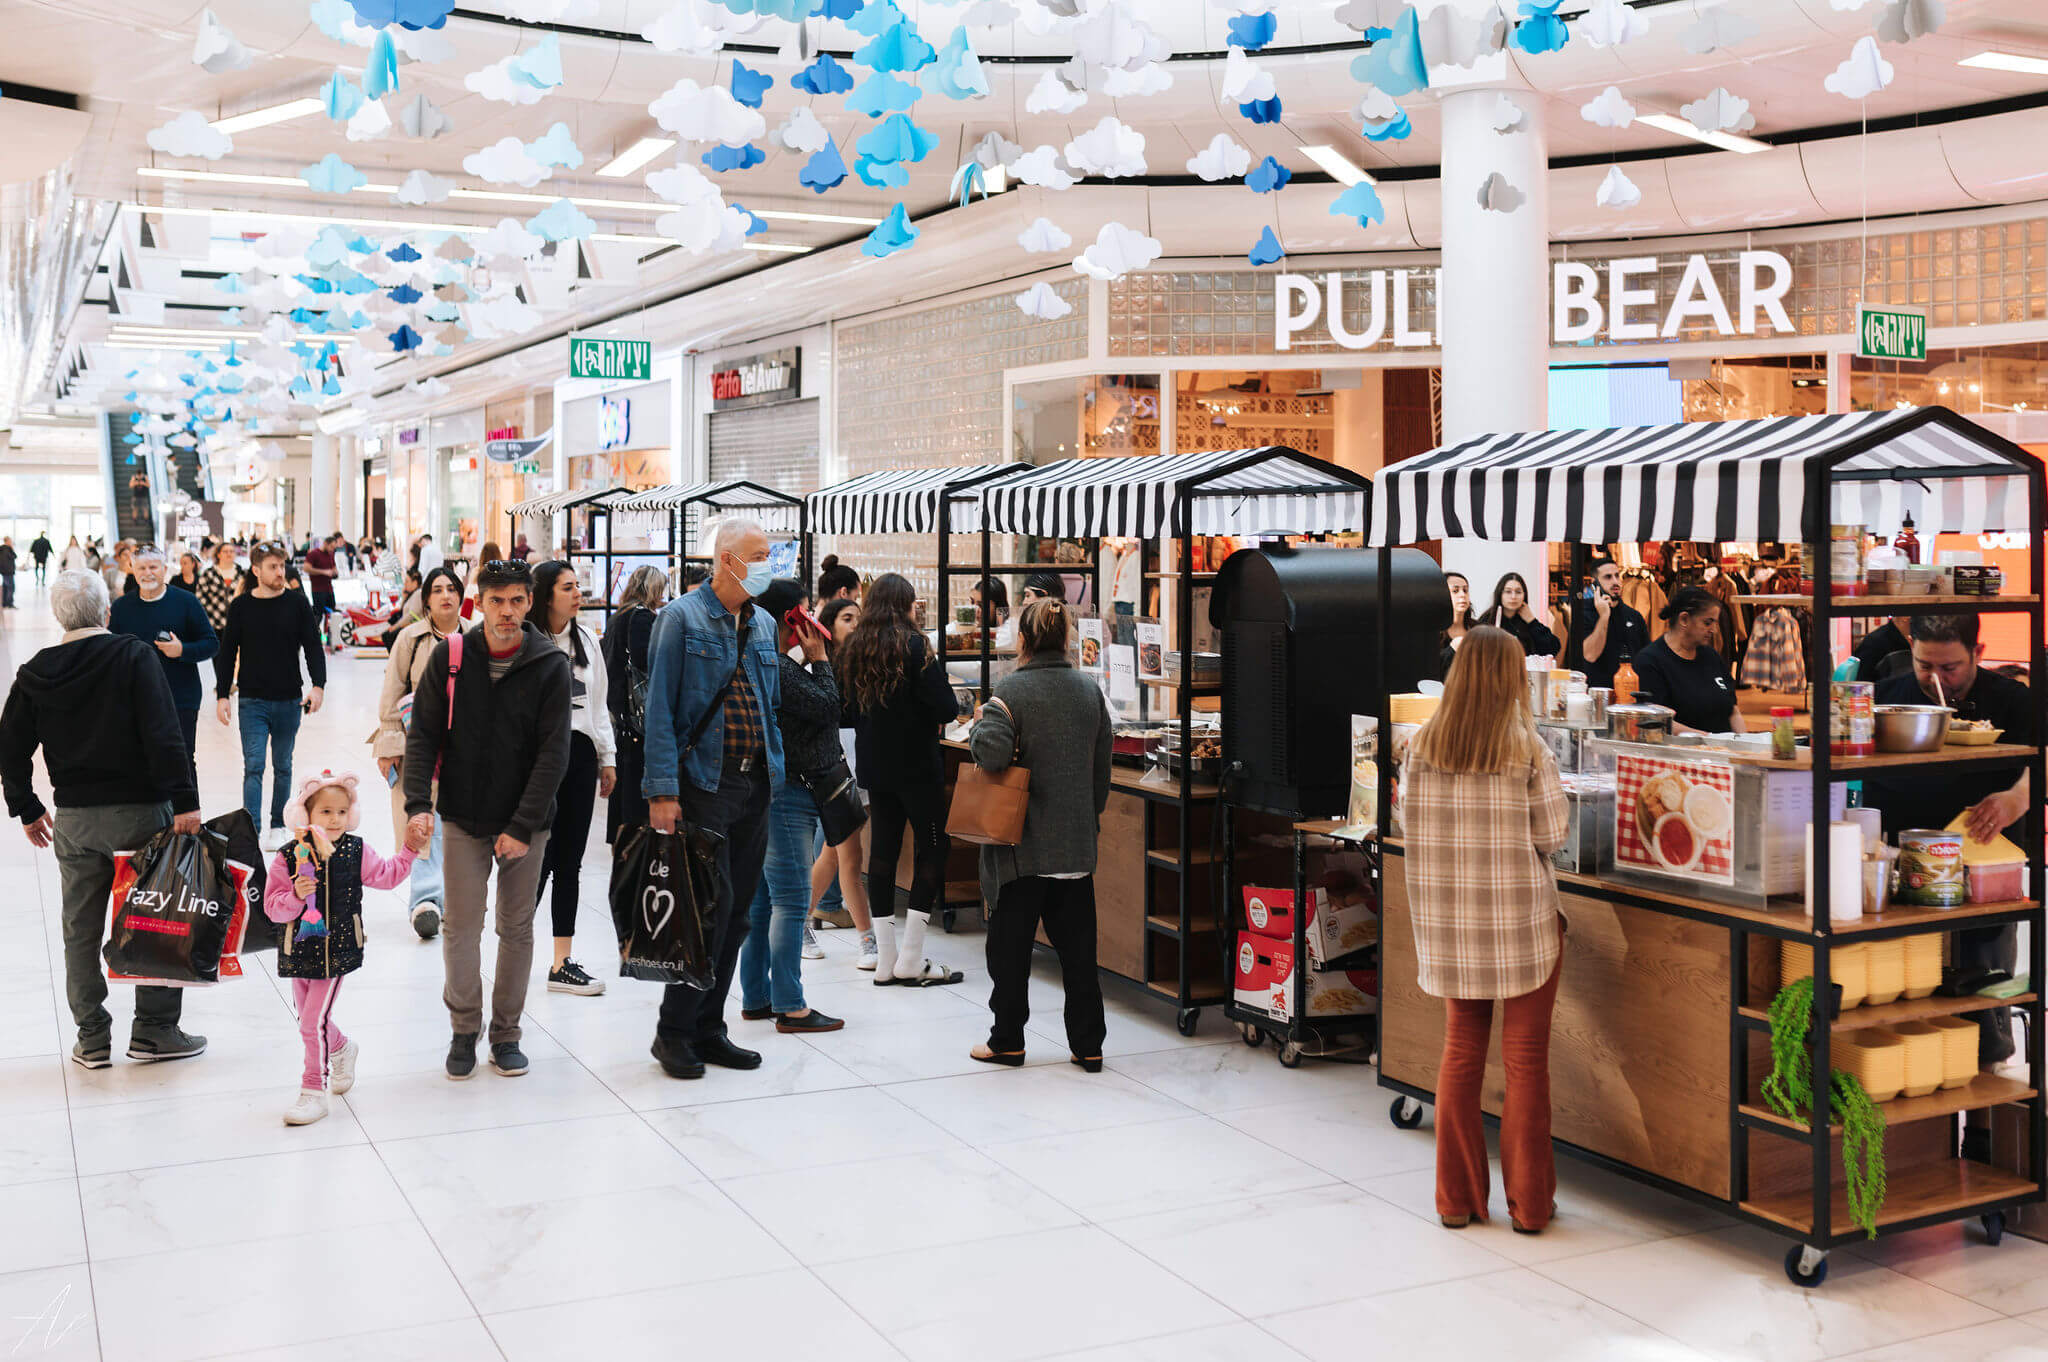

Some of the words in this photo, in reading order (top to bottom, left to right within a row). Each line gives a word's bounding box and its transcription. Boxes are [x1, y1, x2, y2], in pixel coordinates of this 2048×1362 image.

[1275, 269, 1442, 350] PUL
[1554, 250, 1796, 342] BEAR
[1890, 314, 1922, 356] יציאה
[606, 341, 647, 377] יציאה
[126, 887, 173, 912] razy
[177, 885, 219, 917] Line
